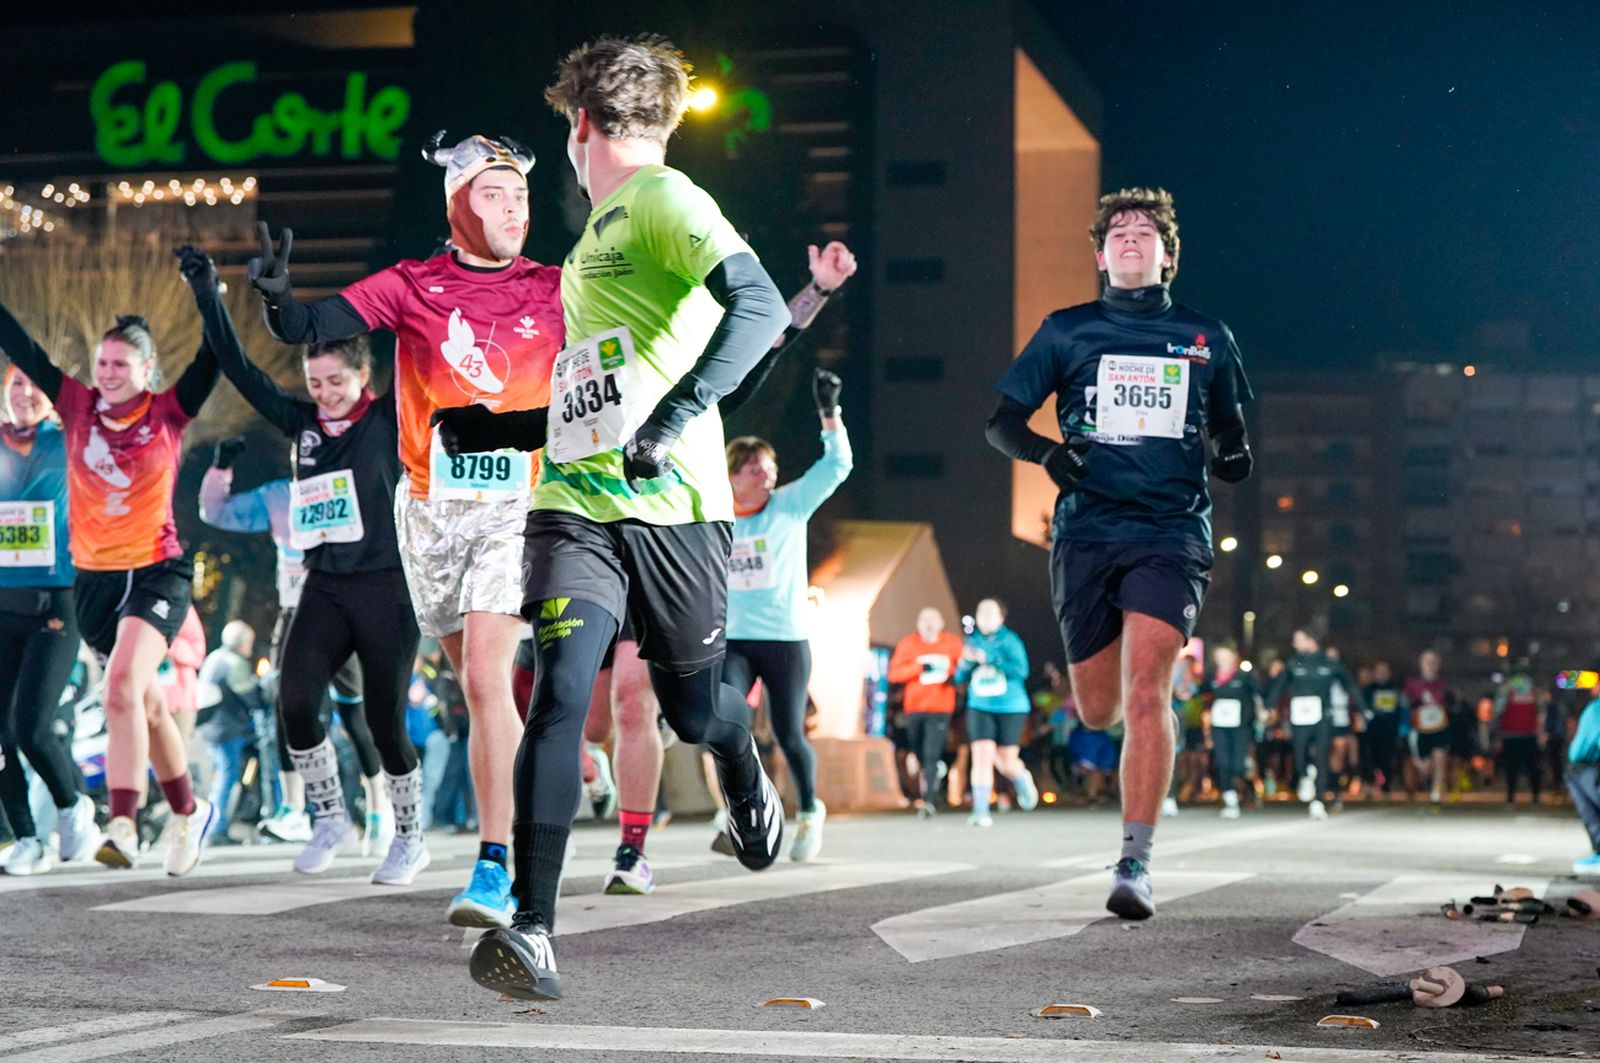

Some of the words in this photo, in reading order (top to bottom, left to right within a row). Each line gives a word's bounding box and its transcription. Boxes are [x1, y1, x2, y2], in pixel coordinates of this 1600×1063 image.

[90, 60, 185, 166] El
[192, 60, 410, 163] Corte
[580, 246, 625, 265] Unicaja
[459, 354, 483, 378] 43
[1108, 373, 1126, 382] SAN
[1127, 373, 1156, 384] ANTÓN
[1118, 365, 1144, 373] NOCHE
[1145, 365, 1156, 373] DE
[562, 373, 622, 424] 3334
[1113, 383, 1172, 409] 3655
[451, 454, 510, 481] 8799
[300, 498, 348, 524] 12982
